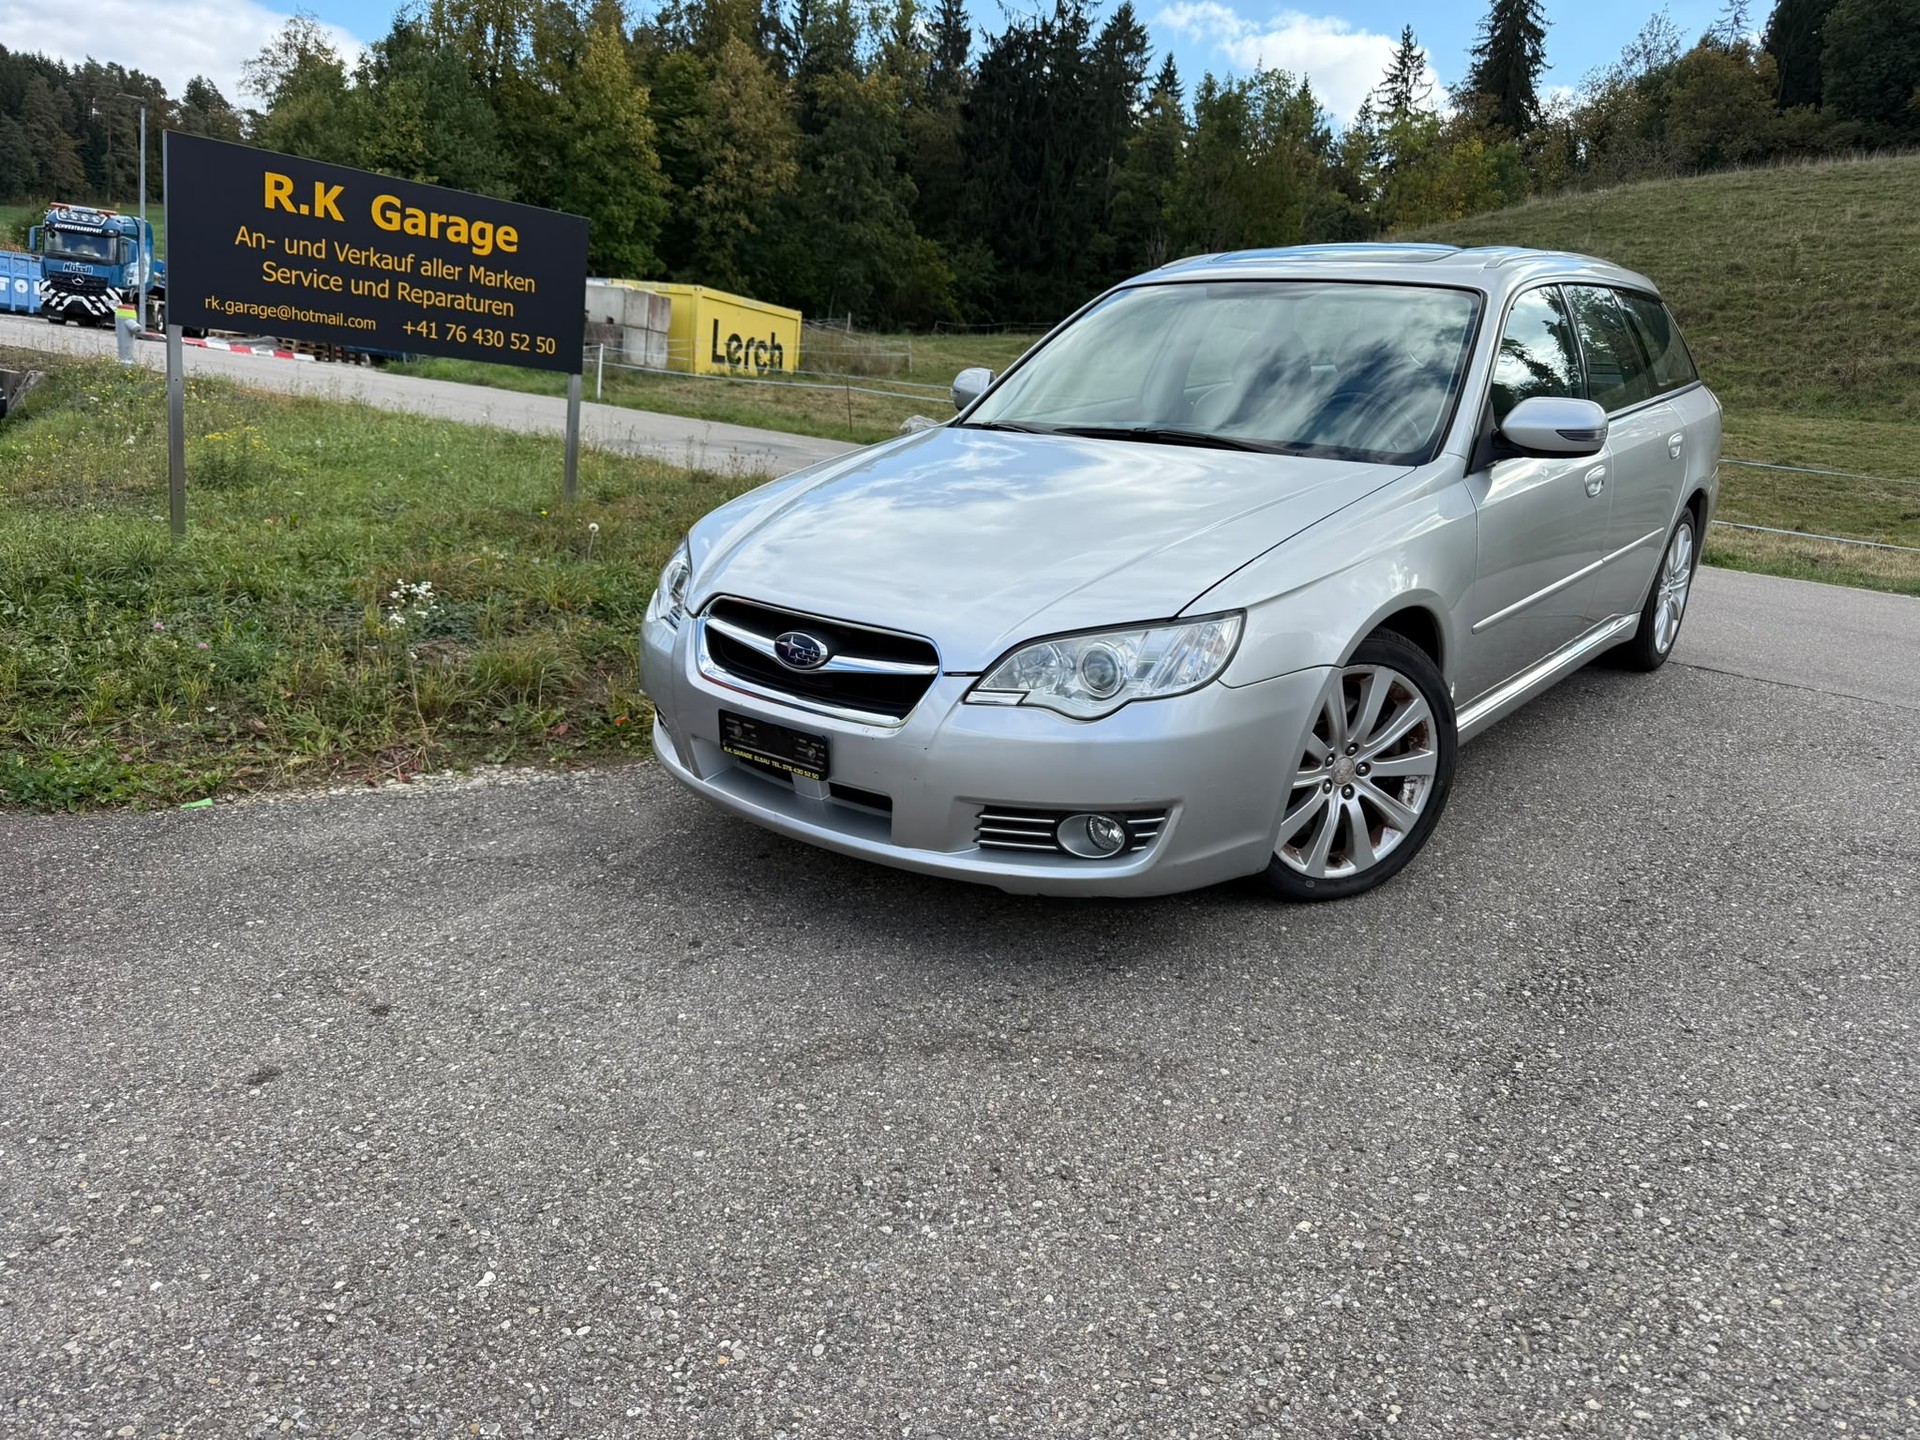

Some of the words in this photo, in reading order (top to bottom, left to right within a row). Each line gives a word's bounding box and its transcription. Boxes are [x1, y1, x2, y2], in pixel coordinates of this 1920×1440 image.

[264, 172, 345, 222] R.K
[371, 194, 519, 256] Garage
[235, 225, 276, 250] An-
[285, 238, 326, 260] und
[334, 241, 415, 275] Verkauf
[420, 257, 463, 281] aller
[469, 265, 536, 293] Marken
[205, 296, 376, 331] rk.garage@hotmail.com
[262, 262, 343, 292] Service
[351, 277, 390, 299] und
[398, 282, 515, 317] Reparaturen
[403, 320, 438, 340] +41
[446, 323, 467, 343] 76
[473, 328, 505, 348] 430
[511, 333, 531, 351] 52
[536, 336, 556, 355] 50
[712, 318, 783, 371] Lerch
[734, 749, 753, 760] GARAGE
